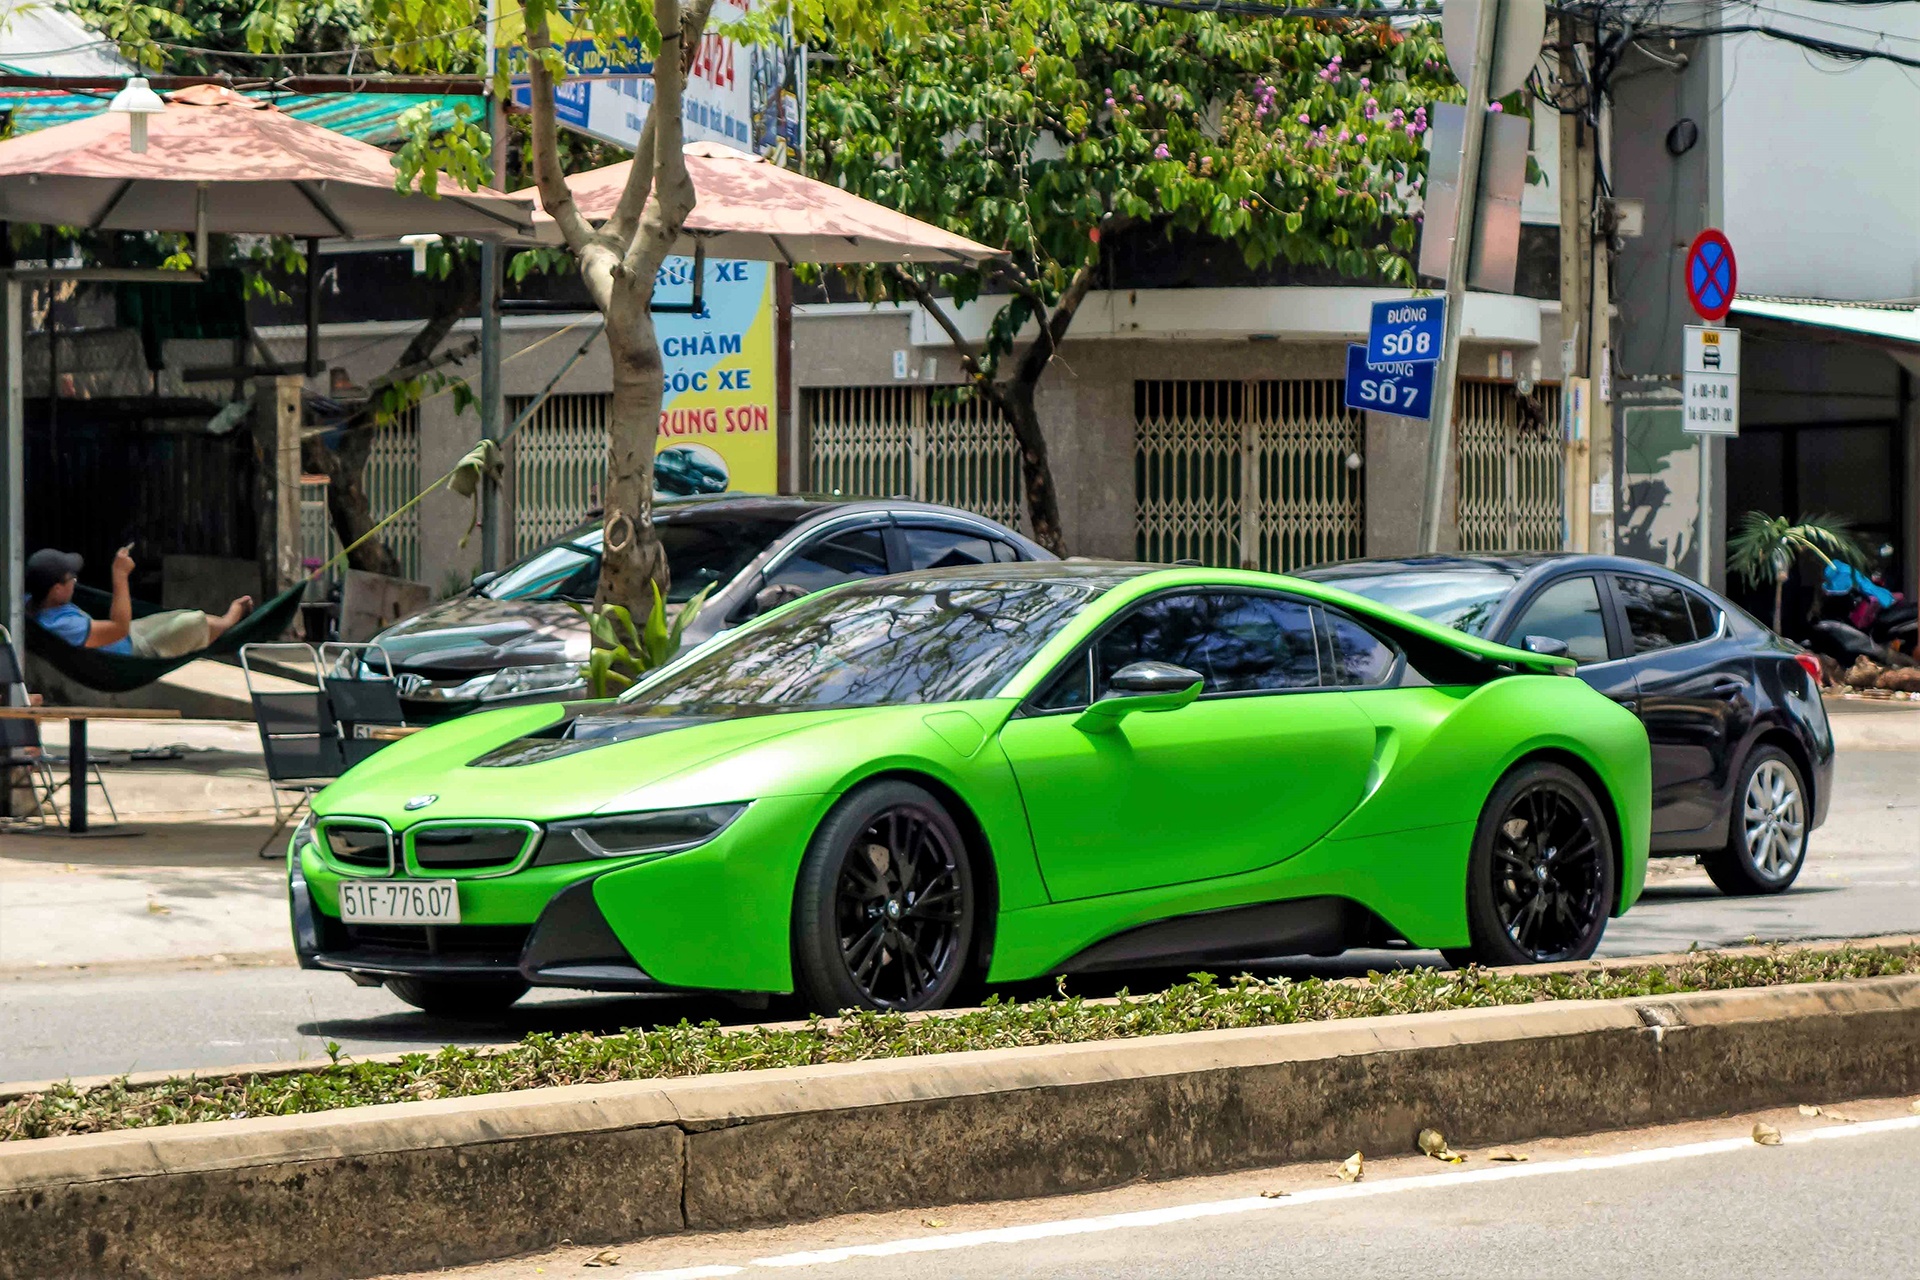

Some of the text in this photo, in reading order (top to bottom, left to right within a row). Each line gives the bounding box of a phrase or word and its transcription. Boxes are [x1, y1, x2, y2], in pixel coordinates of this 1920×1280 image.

[715, 260, 750, 283] XE
[1388, 305, 1427, 324] ĐƯỜNG
[663, 330, 742, 357] CHĂM
[1381, 324, 1431, 356] SỐ 8
[718, 369, 752, 391] XE
[1360, 376, 1419, 408] SỐ 7
[657, 402, 769, 438] RUNG SƠN
[343, 885, 453, 918] 51F-776.07
